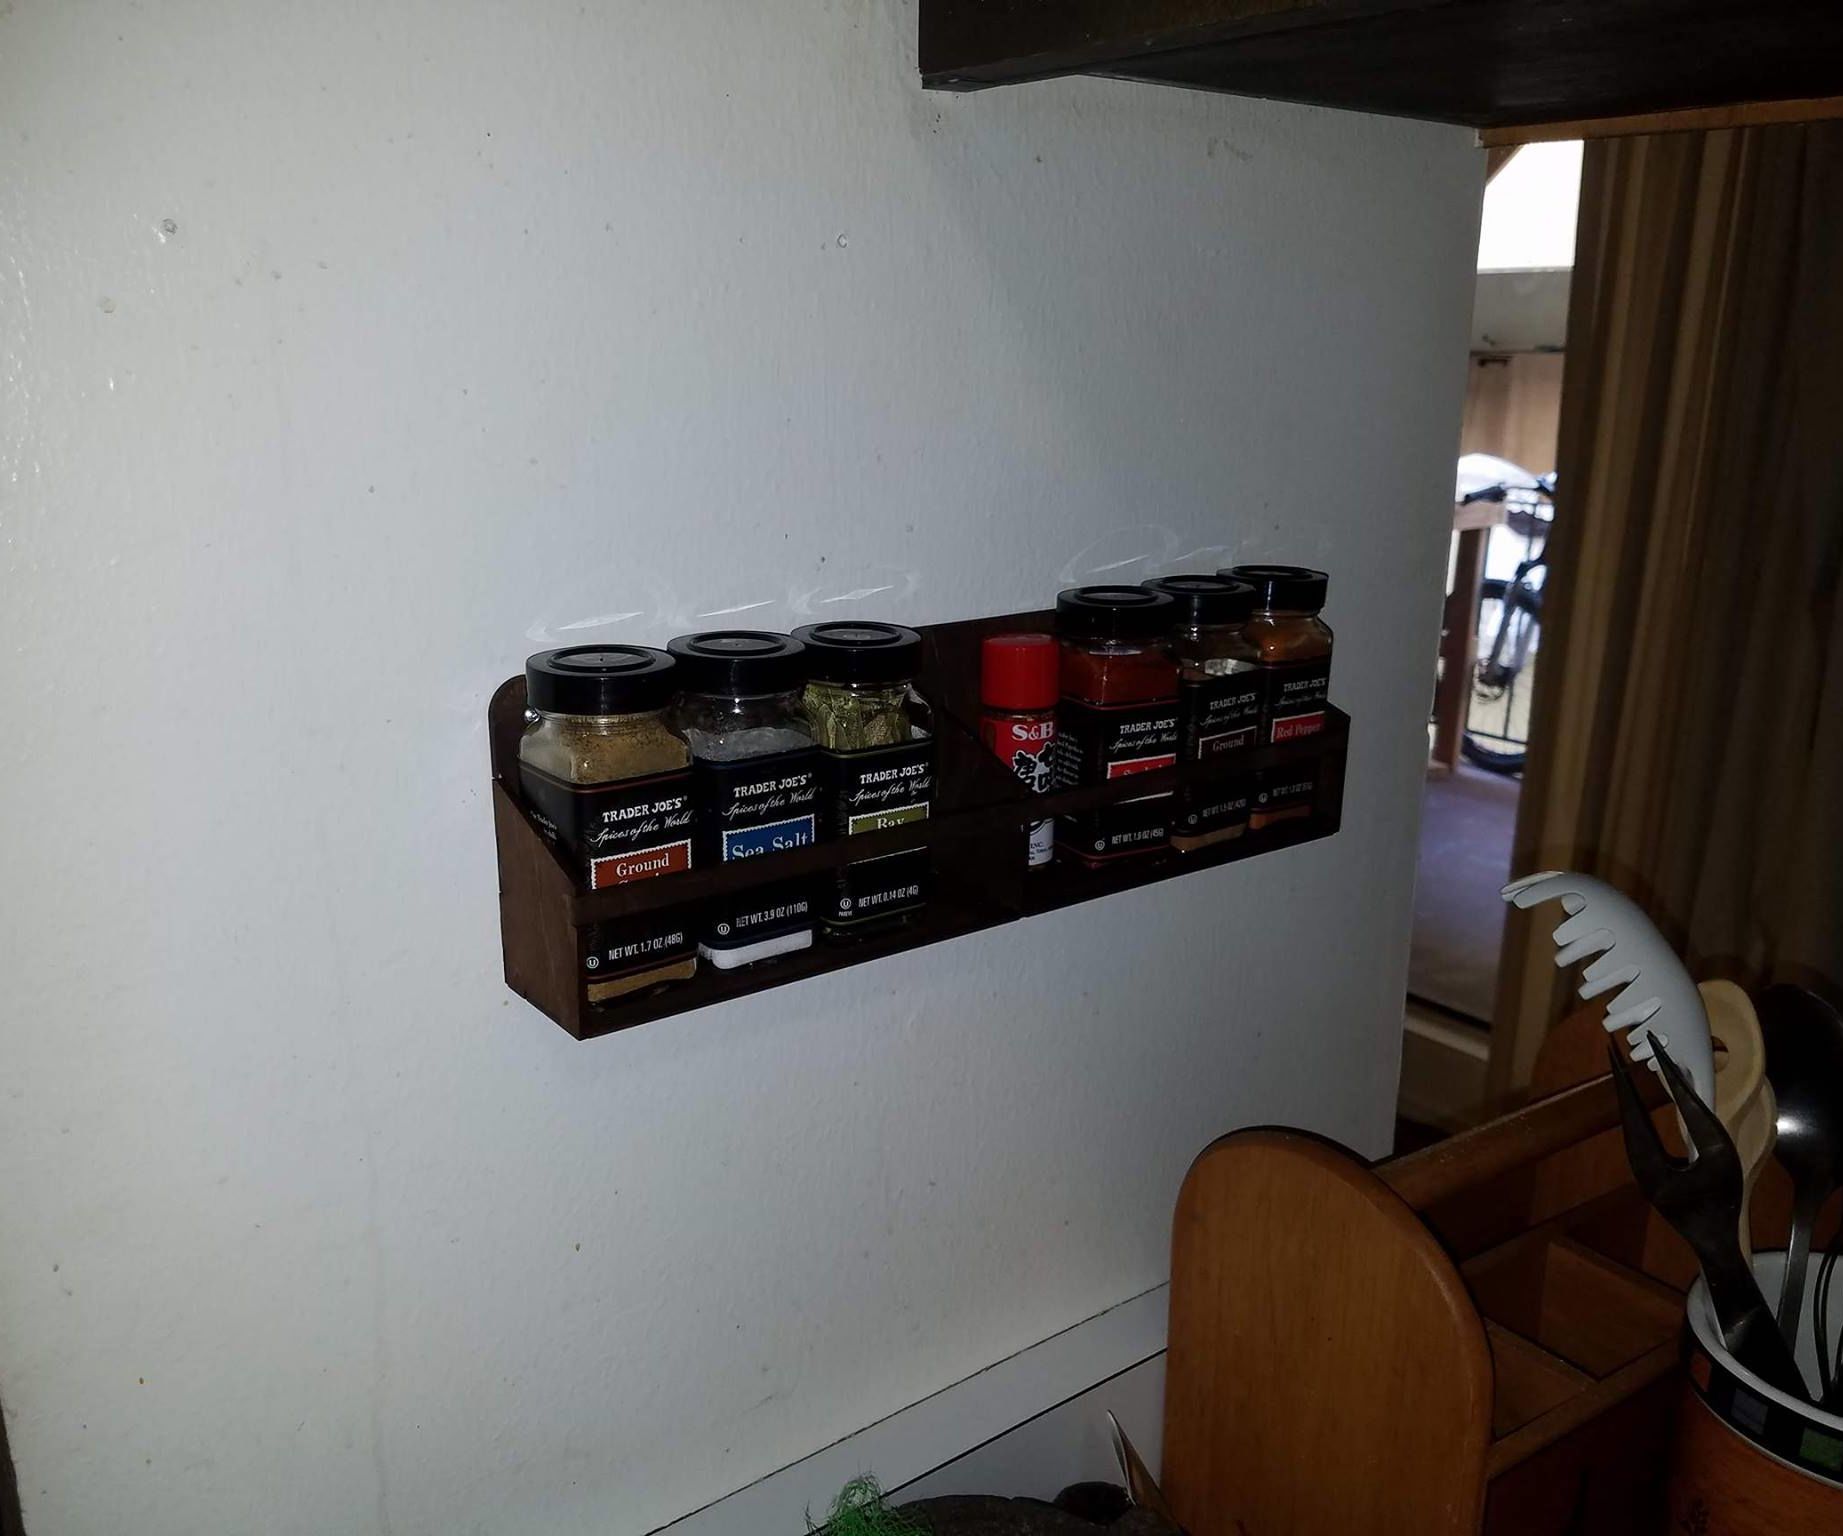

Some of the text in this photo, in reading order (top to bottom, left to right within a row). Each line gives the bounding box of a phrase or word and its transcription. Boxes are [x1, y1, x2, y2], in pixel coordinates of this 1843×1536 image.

[1209, 696, 1237, 710] TRADER
[1011, 721, 1054, 742] S&B
[1120, 718, 1176, 734] TRADER JOE'S
[1276, 721, 1322, 739] Red Pepper
[1212, 735, 1246, 752] Ground
[733, 773, 808, 798] TRADER JOE'S
[859, 763, 926, 785] TRADER JOE'S
[848, 788, 882, 807] Spices
[908, 776, 933, 793] World
[602, 796, 683, 824] TRADER JOE'S
[721, 802, 760, 822] Spices
[789, 786, 818, 804] World
[590, 826, 629, 848] Spices
[664, 808, 695, 829] World
[732, 832, 809, 860] Sea Salt
[615, 853, 671, 878] Ground
[858, 896, 871, 908] NET
[897, 887, 906, 899] OZ
[736, 914, 750, 929] NET
[750, 910, 764, 925] WT.
[775, 905, 786, 918] OZ
[608, 930, 684, 961] NET WT. 1.7 OZ (48G)
